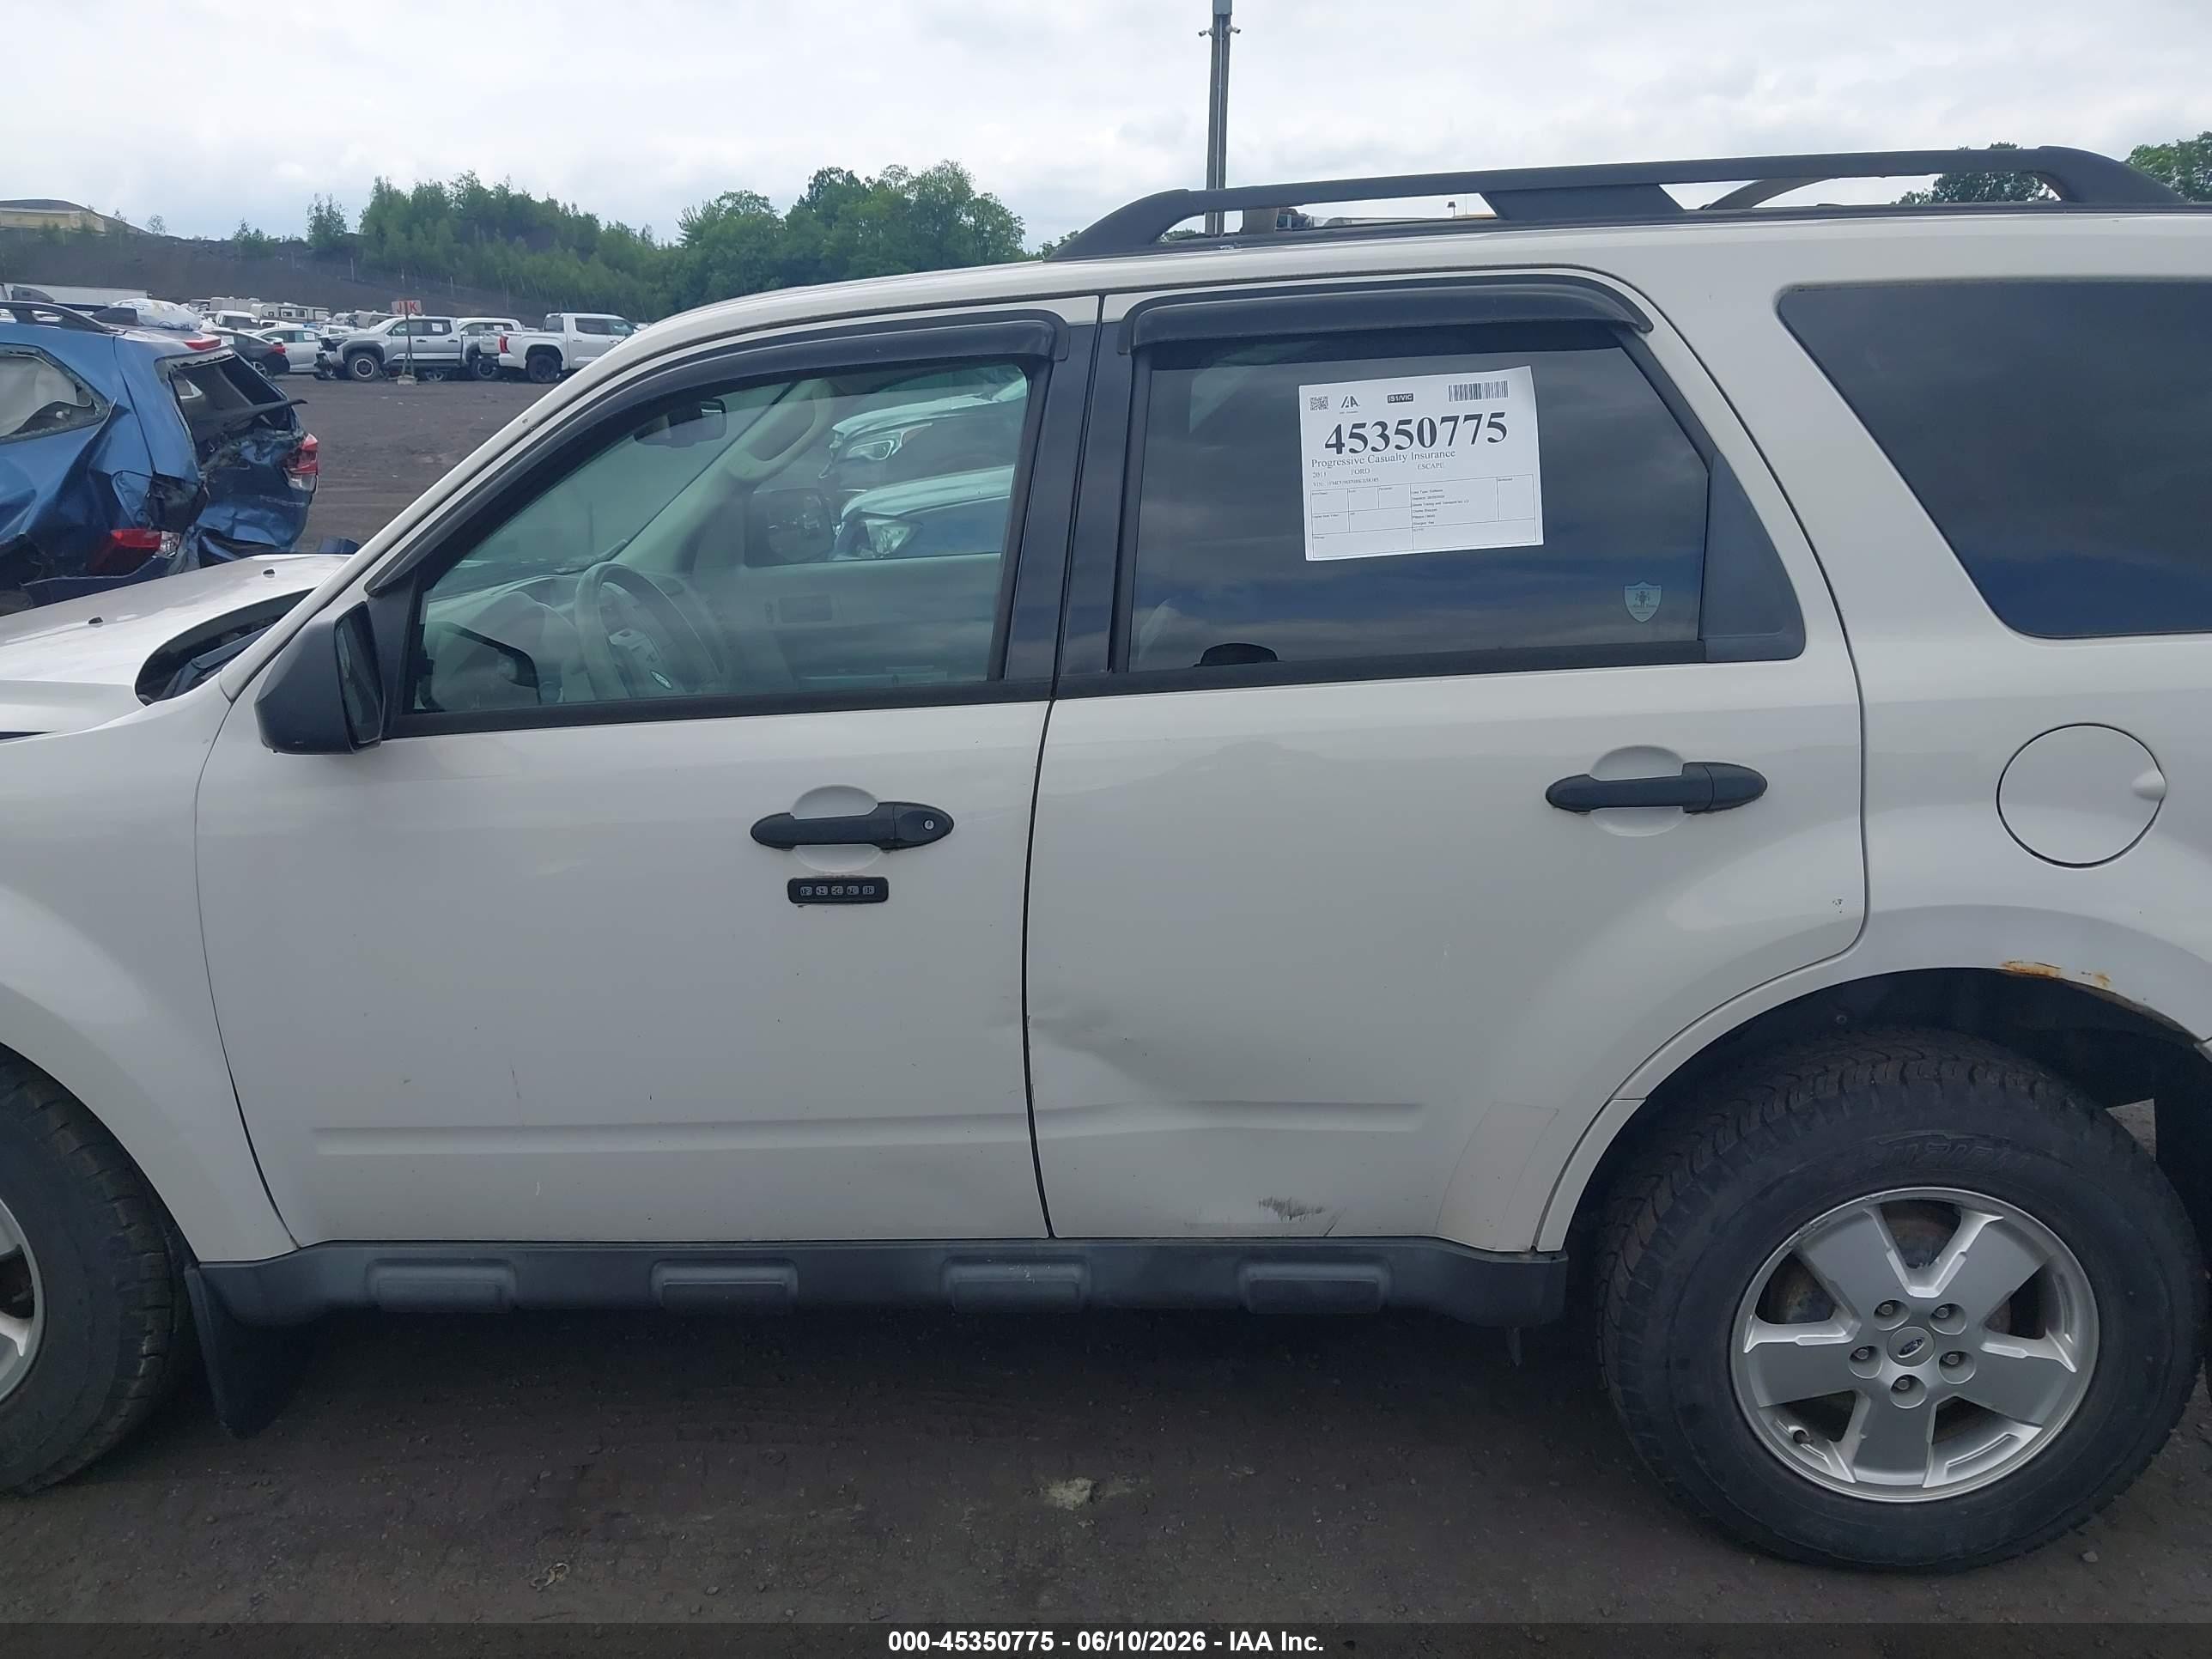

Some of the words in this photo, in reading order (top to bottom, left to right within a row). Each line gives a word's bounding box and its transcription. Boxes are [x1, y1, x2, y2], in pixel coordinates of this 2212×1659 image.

[1324, 411, 1508, 455] 45350775
[1310, 457, 1364, 469] Progressive
[1367, 453, 1408, 464] Casualty
[1411, 450, 1456, 461] Insurance
[1417, 462, 1444, 471] ESCAPE
